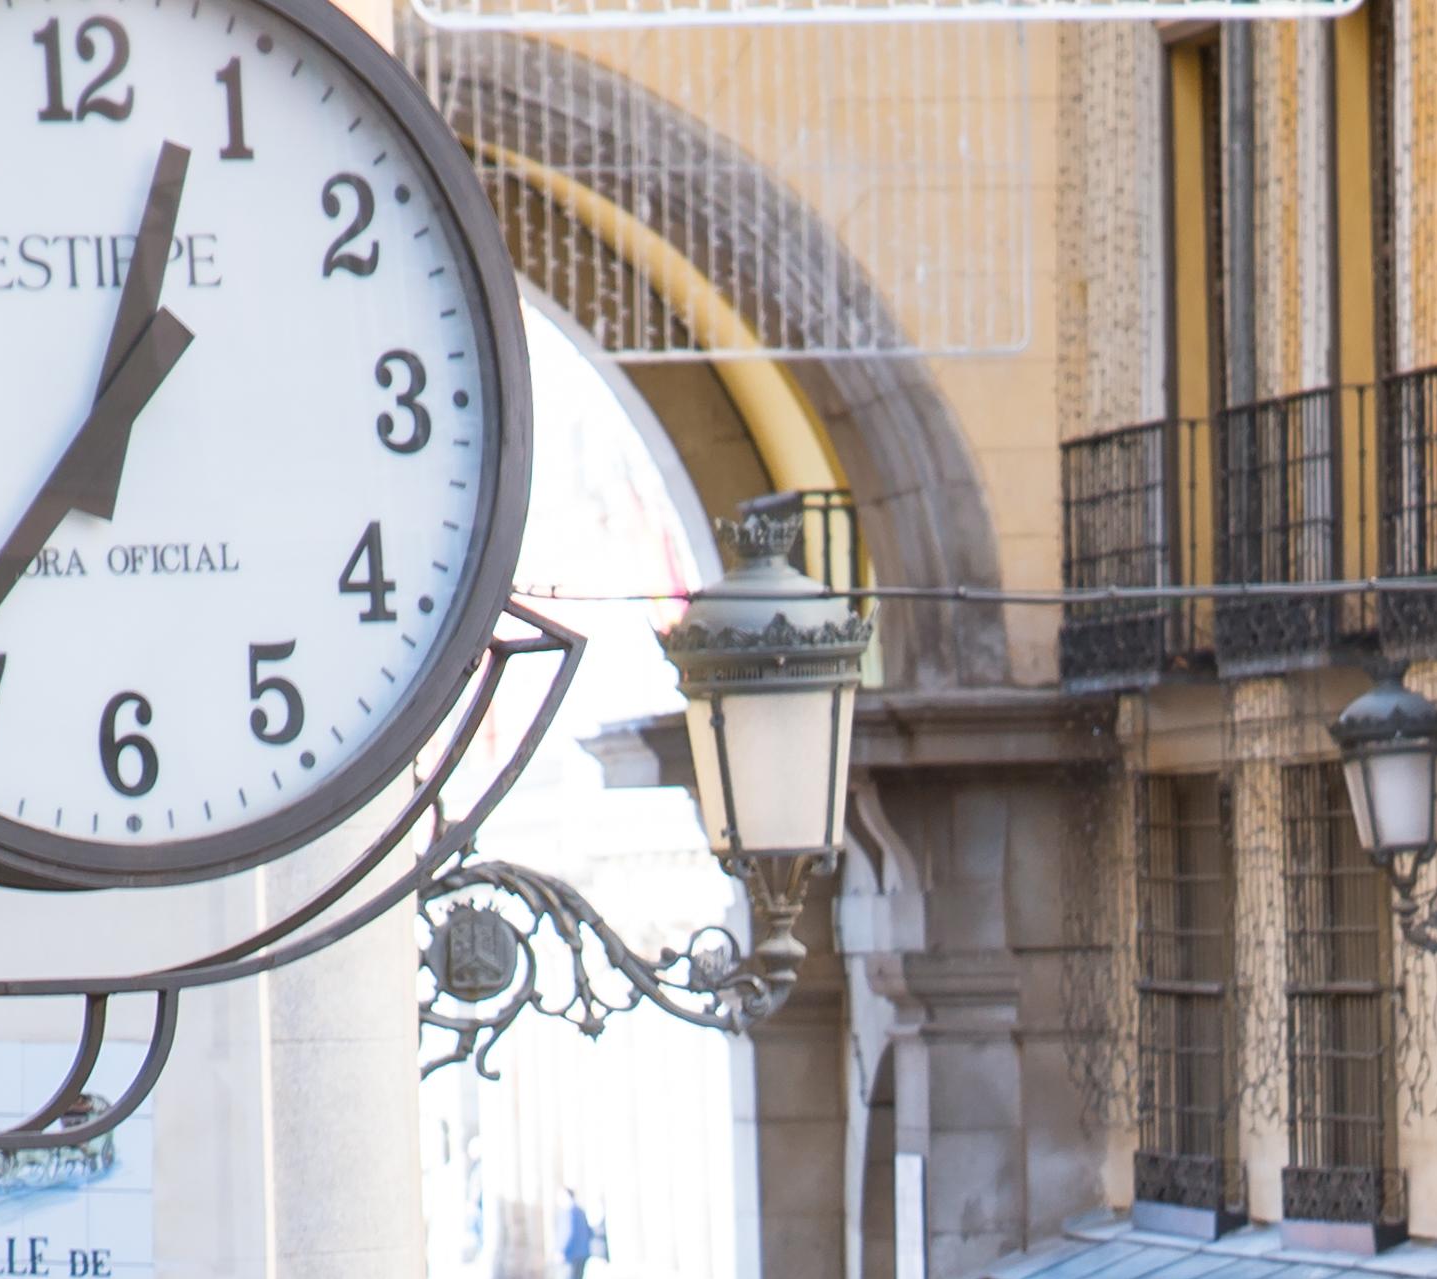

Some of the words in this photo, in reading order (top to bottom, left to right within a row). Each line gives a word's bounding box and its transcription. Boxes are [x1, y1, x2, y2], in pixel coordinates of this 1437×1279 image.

[33, 17, 135, 123] 12
[216, 56, 255, 161] 1
[321, 173, 380, 279] 2
[373, 349, 432, 454] 3
[15, 546, 86, 578] ORA
[107, 542, 240, 576] OFICIAL
[338, 521, 397, 623] 4
[98, 691, 160, 797] 6
[247, 639, 306, 745] 5
[68, 1248, 113, 1279] DE
